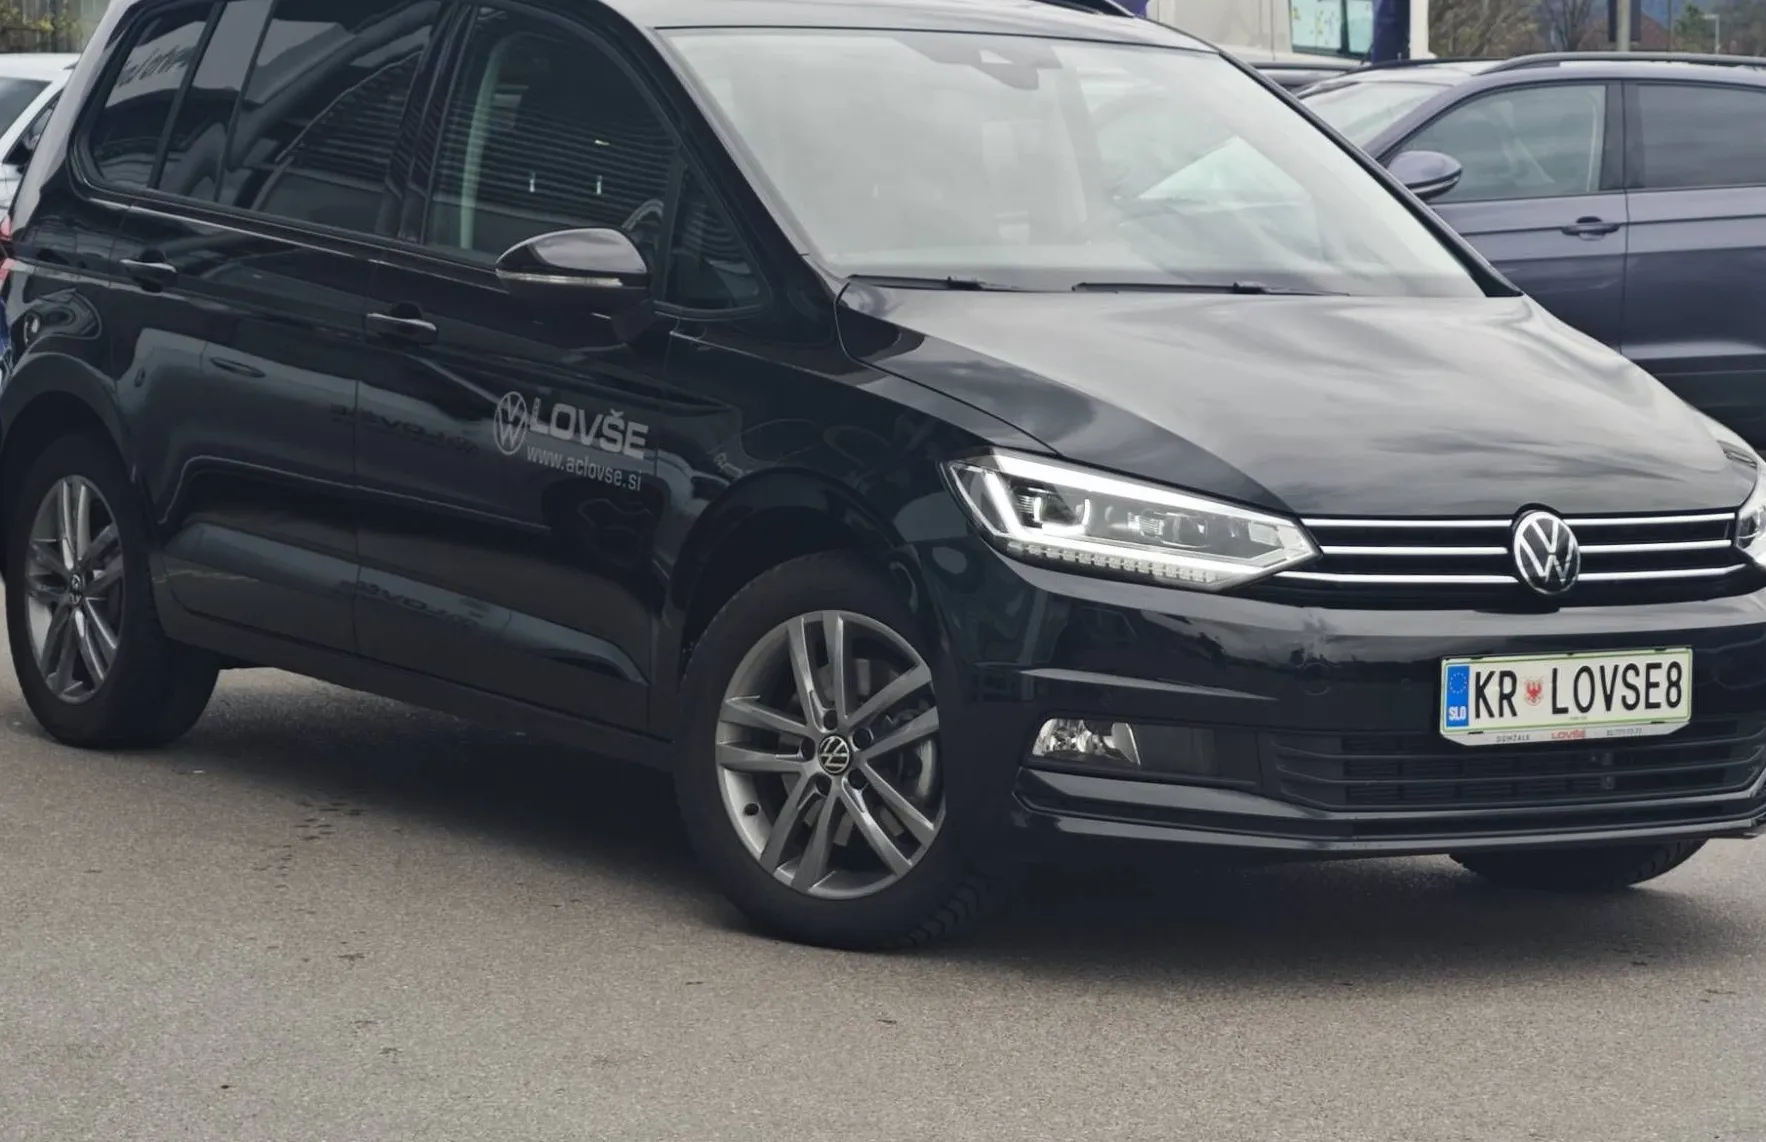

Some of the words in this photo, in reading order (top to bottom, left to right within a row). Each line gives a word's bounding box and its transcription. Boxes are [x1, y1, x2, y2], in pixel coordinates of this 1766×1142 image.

[494, 391, 528, 455] VW
[530, 397, 649, 460] LOVŠE
[526, 445, 642, 491] www.aclovse.si
[1514, 511, 1580, 594] VW
[1449, 705, 1467, 721] SLO
[1475, 670, 1518, 719] KR
[1552, 661, 1683, 714] LOVSE8
